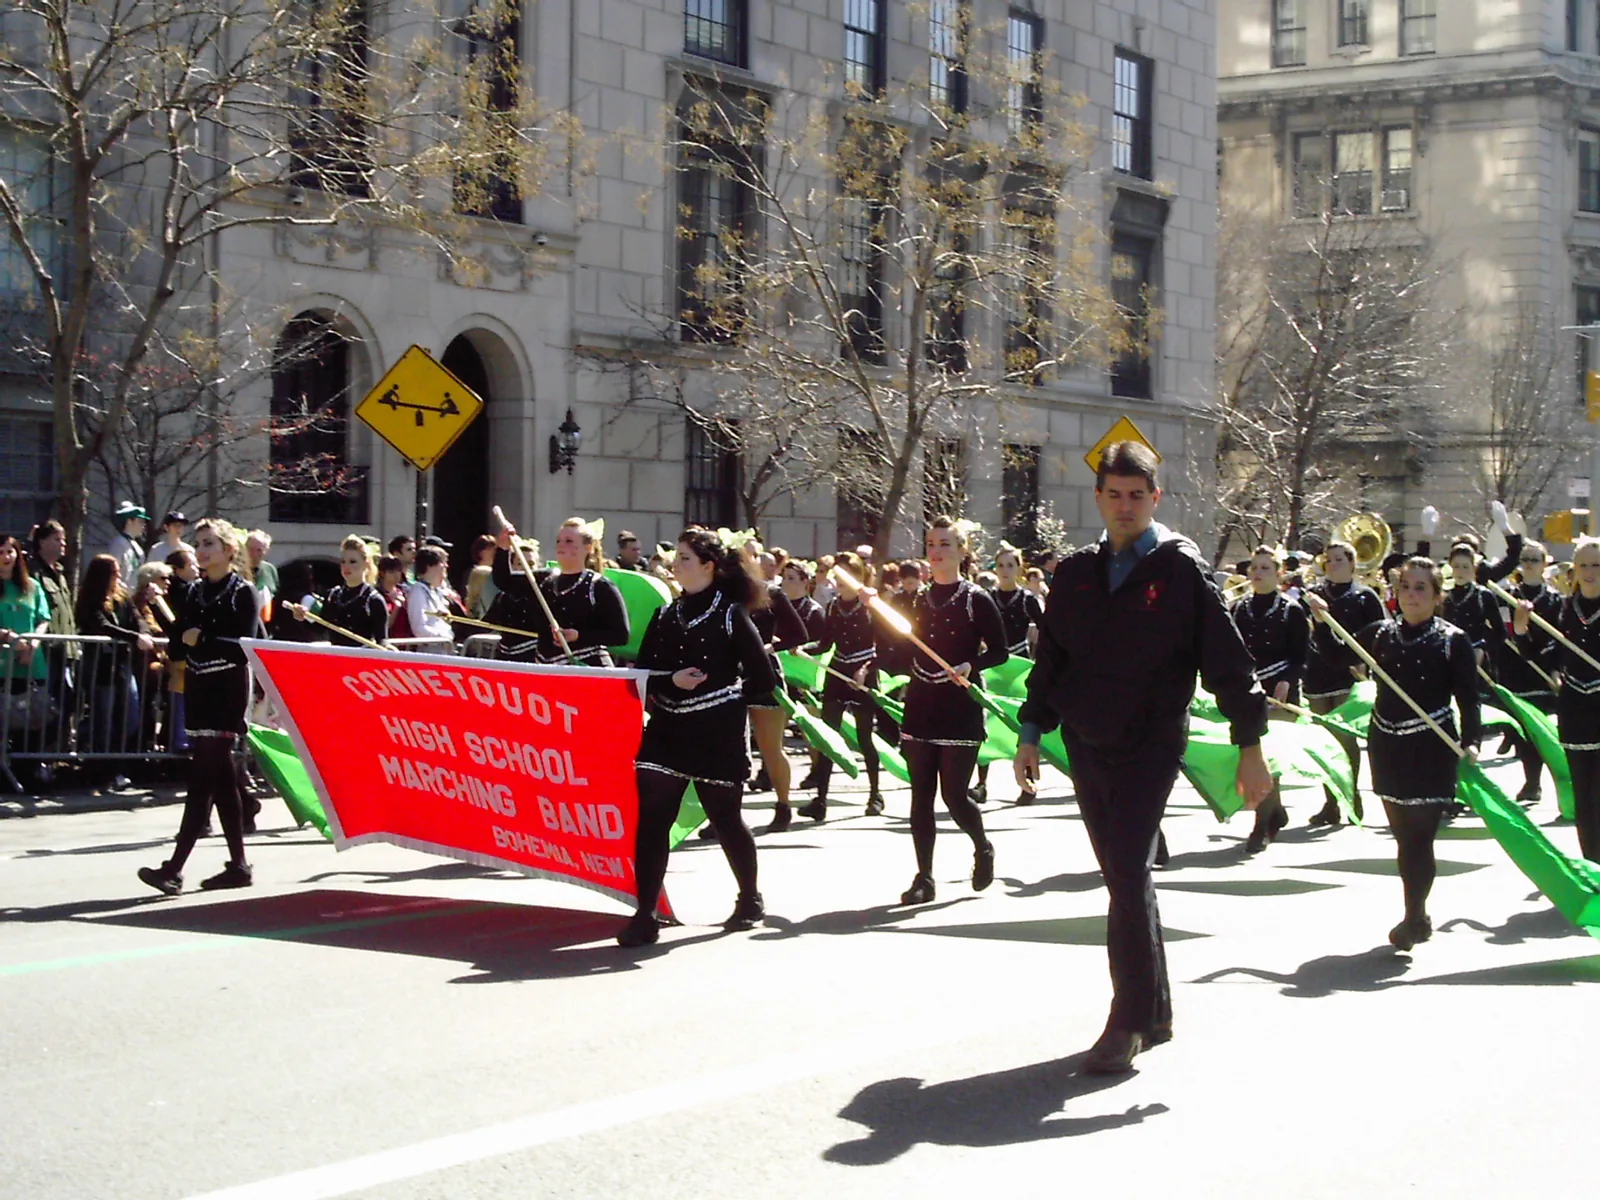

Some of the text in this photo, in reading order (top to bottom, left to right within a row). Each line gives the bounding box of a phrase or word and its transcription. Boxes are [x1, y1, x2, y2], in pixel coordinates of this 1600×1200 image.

[342, 667, 579, 734] CONNETQUOT
[380, 714, 589, 786] HIGH SCHOOL
[378, 754, 625, 840] MARCHING BAND
[492, 825, 580, 872] BOHEMIA,
[580, 851, 625, 879] NEW
